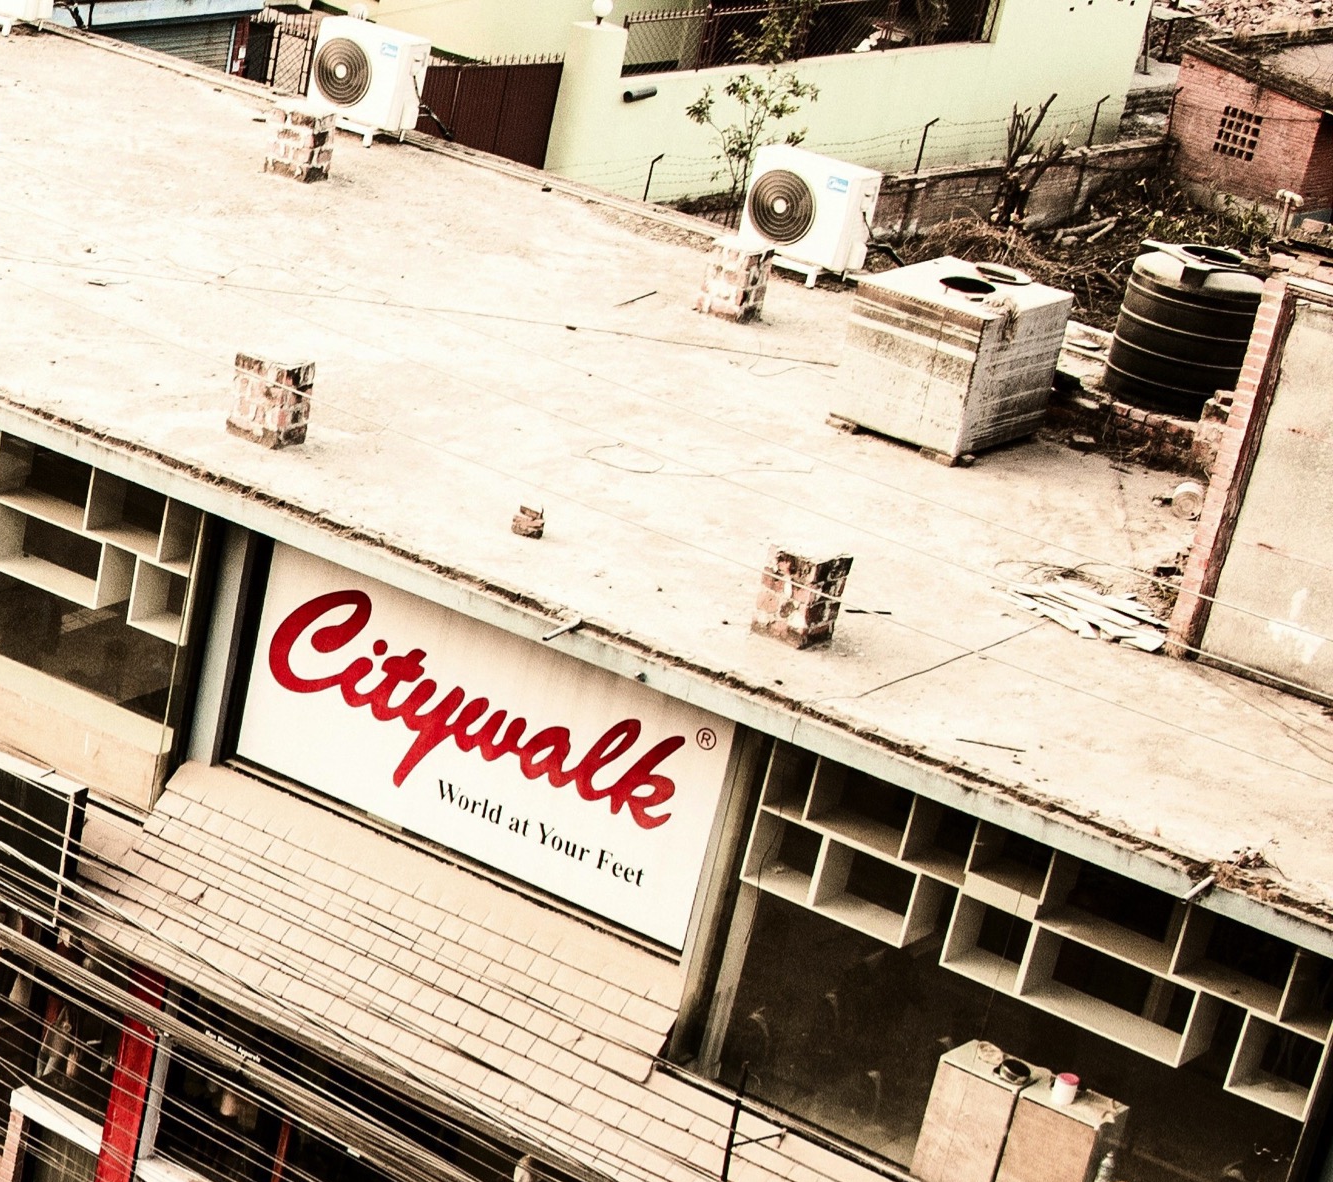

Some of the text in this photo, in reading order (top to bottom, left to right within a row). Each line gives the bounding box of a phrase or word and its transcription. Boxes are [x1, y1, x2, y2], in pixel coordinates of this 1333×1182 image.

[269, 590, 685, 830] Citywalk
[438, 779, 645, 888] World at Your Feet
